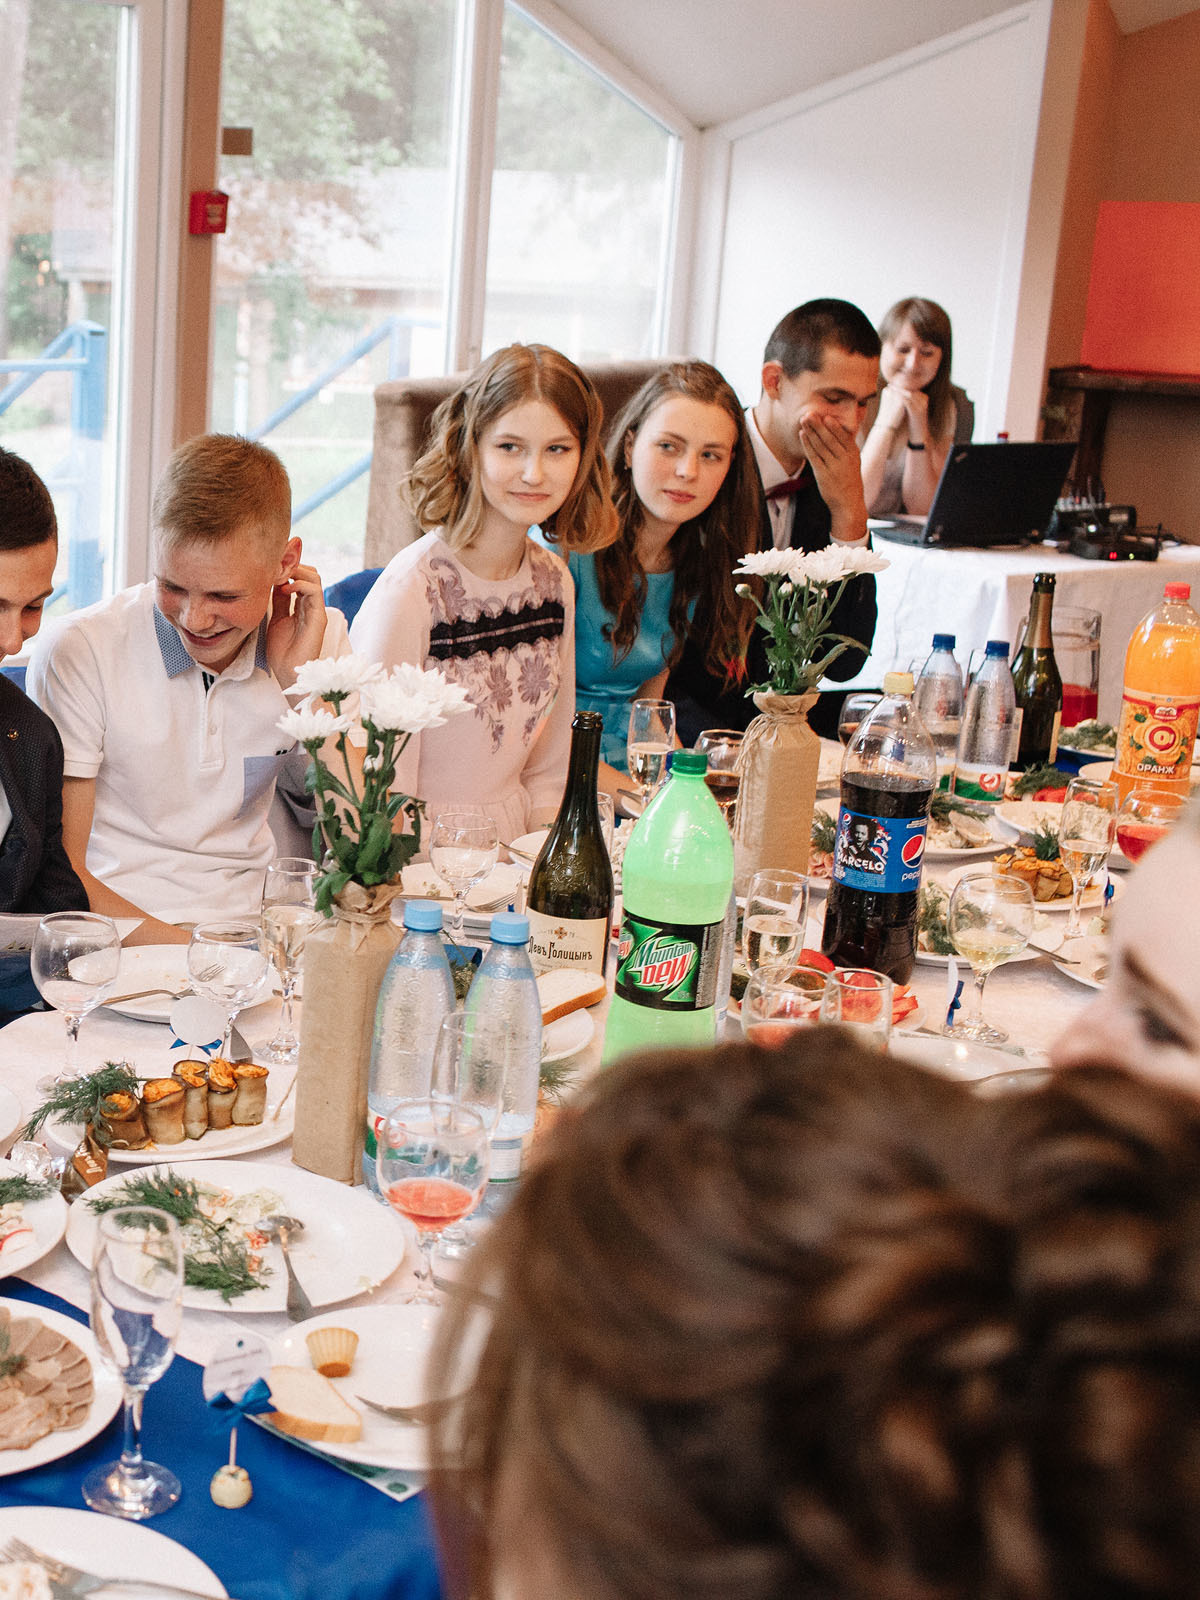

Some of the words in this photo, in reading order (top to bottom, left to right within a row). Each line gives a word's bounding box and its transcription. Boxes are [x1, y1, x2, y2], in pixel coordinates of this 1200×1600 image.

[1136, 763, 1175, 774] ОРАНЖ
[837, 851, 886, 871] MARCELO
[901, 870, 921, 882] peps
[547, 941, 593, 961] Голицынъ
[634, 940, 693, 968] Mountain
